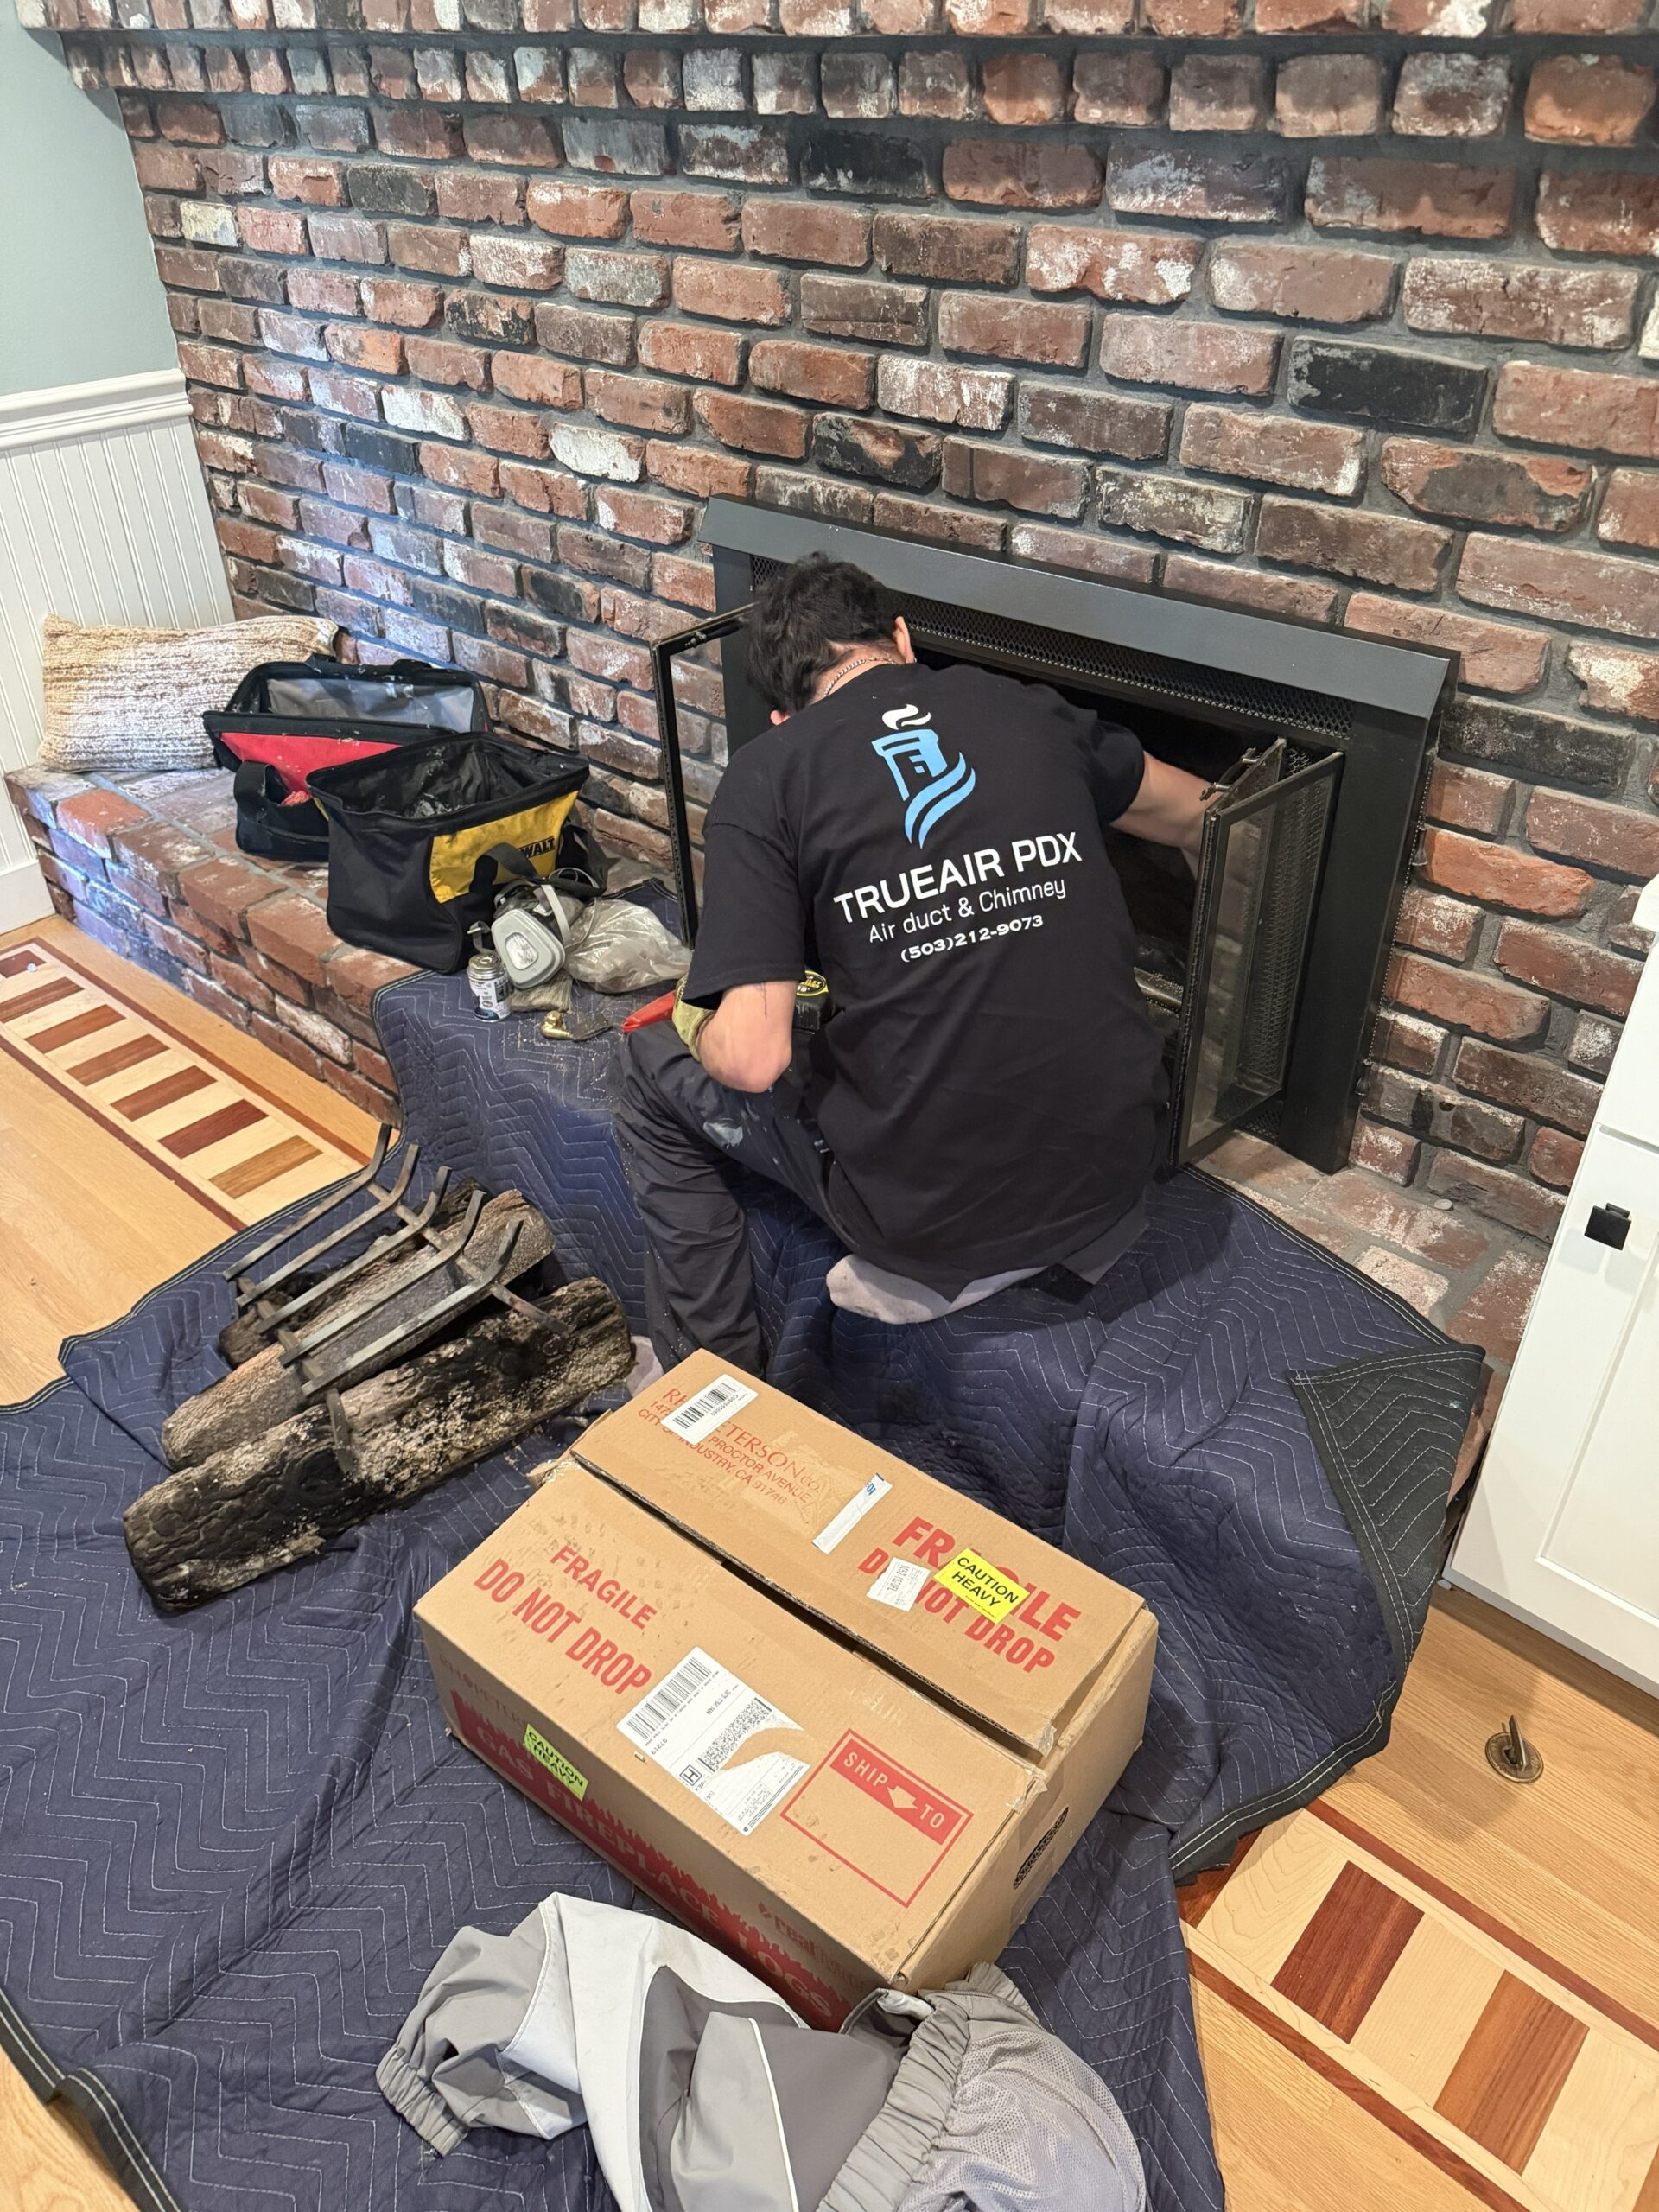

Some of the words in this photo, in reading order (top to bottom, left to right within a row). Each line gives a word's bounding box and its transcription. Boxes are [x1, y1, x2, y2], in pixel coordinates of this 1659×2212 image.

[833, 849, 1005, 924] TRUEAIR
[1011, 831, 1083, 873] PDX
[868, 924, 896, 944] Air
[903, 903, 952, 934] duct
[958, 897, 975, 918] &
[979, 879, 1066, 913] Chimney
[900, 915, 1044, 963] (503)212-9073
[708, 1436, 764, 1473] PROCTOR
[761, 1471, 812, 1503] AVENUE
[734, 1469, 753, 1484] CA
[753, 1480, 787, 1504] 91746
[550, 1545, 658, 1630] FRAGILE
[951, 1571, 1001, 1608] HEAVY
[957, 1556, 1019, 1604] CAUTION
[474, 1558, 525, 1603] DO
[512, 1587, 582, 1643] NOT
[565, 1626, 652, 1695] DROP
[964, 1615, 1056, 1674] DROP
[528, 1731, 584, 1788] CAUTION
[533, 1744, 575, 1785] HEAVY
[683, 1768, 699, 1783] H
[842, 1751, 888, 1789] SHIP
[917, 1803, 945, 1830] TO
[477, 1726, 534, 1781] GAS
[546, 1783, 721, 1924] FIREPLACE
[738, 1932, 831, 2018] LOGS
